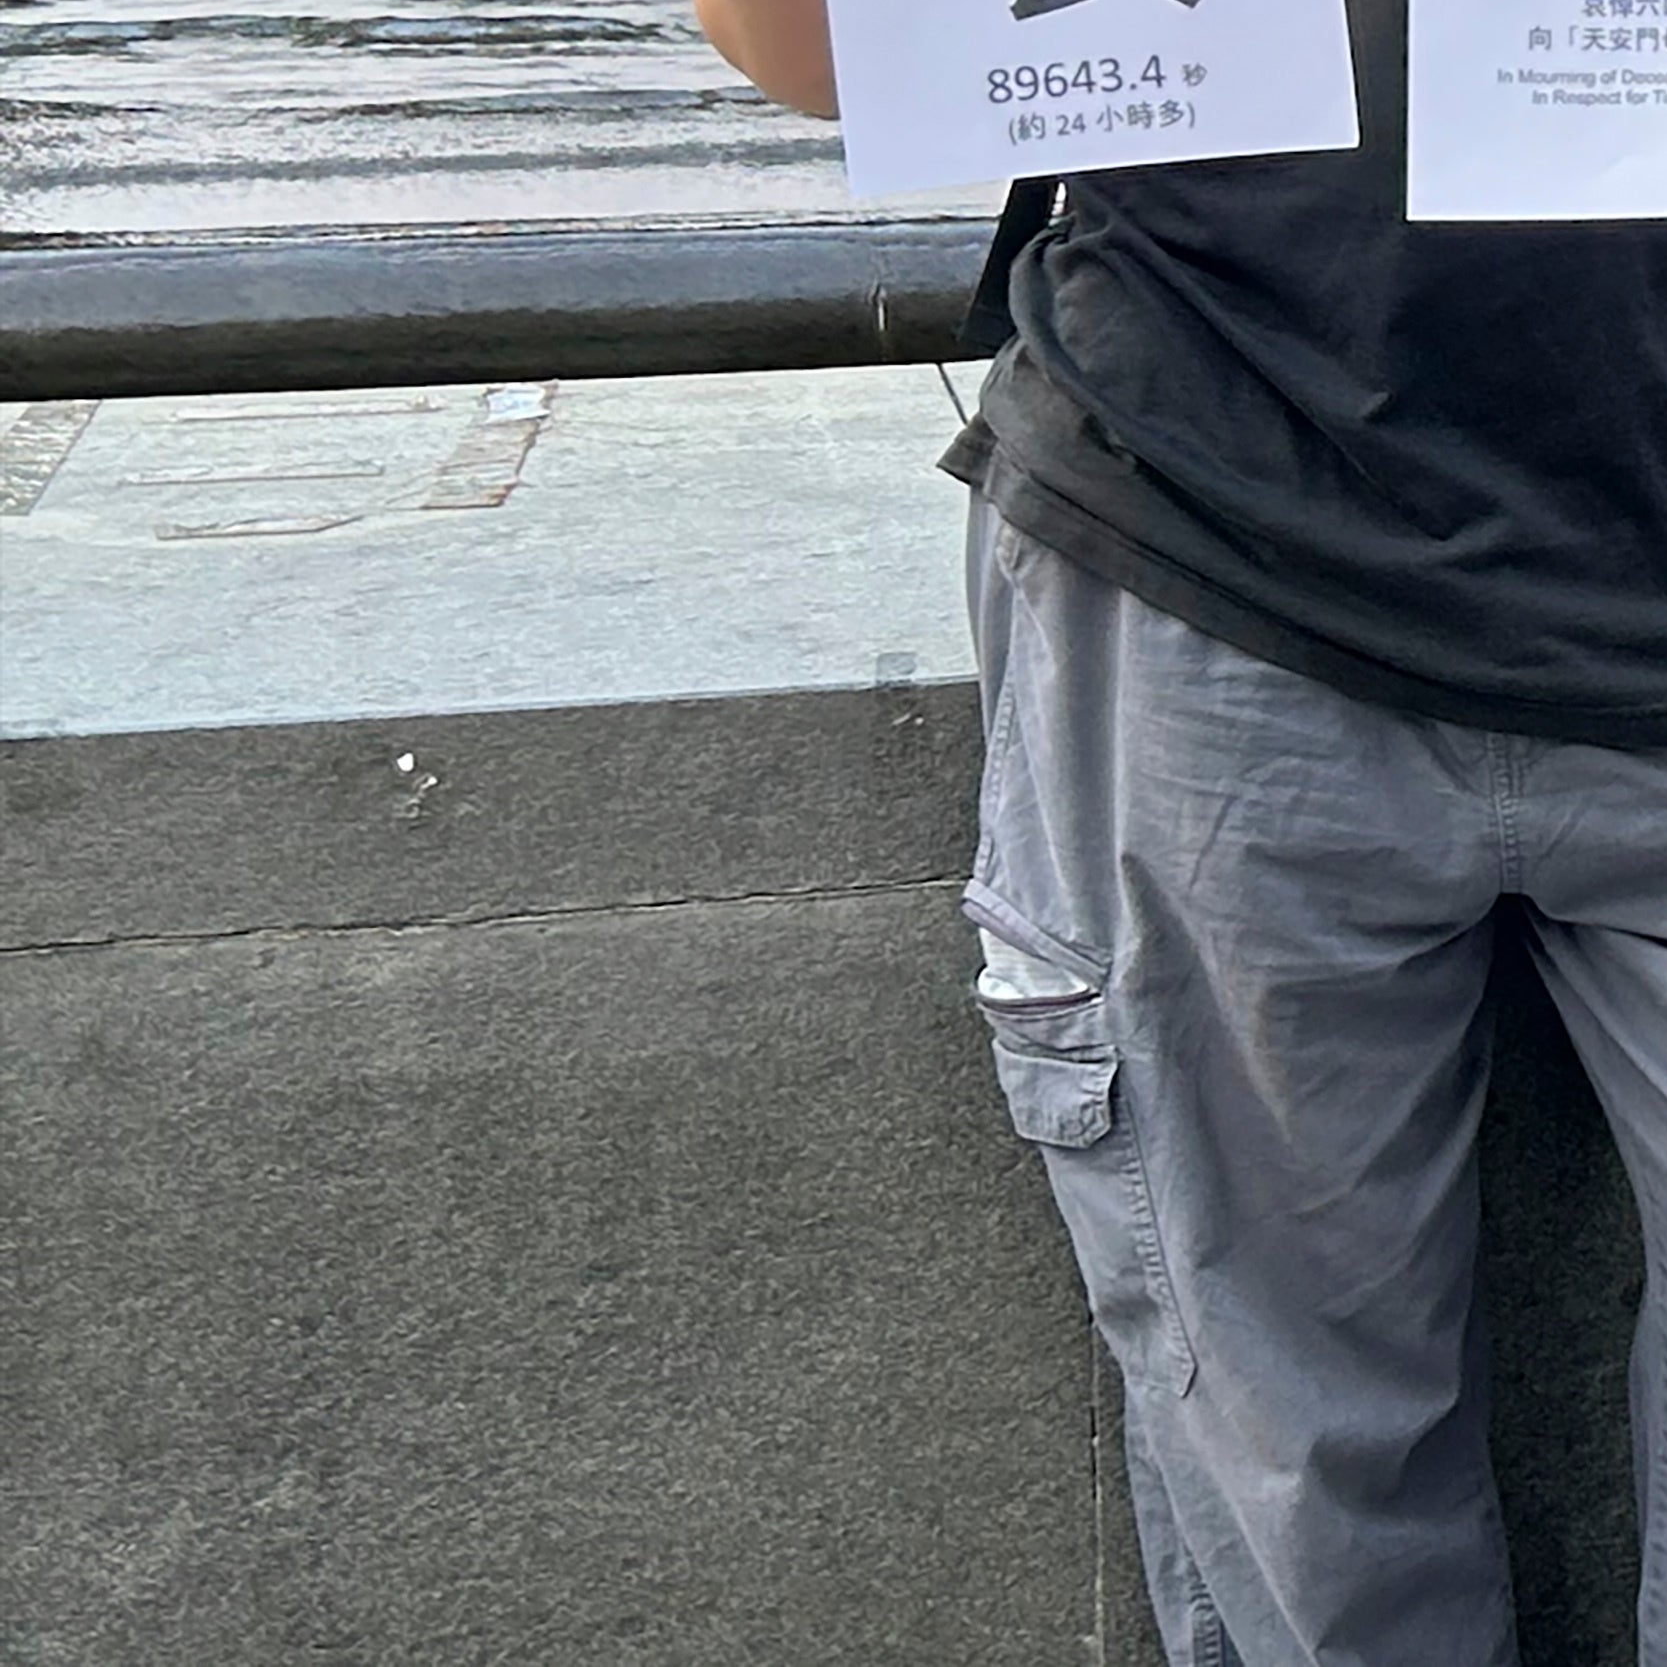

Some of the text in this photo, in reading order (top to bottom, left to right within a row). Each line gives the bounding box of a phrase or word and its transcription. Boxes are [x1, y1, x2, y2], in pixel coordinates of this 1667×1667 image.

[1498, 69, 1513, 83] In
[1519, 68, 1595, 87] Mourning
[1600, 68, 1617, 84] of
[1533, 90, 1548, 104] In
[1552, 89, 1621, 107] Respect
[1627, 89, 1648, 104] for
